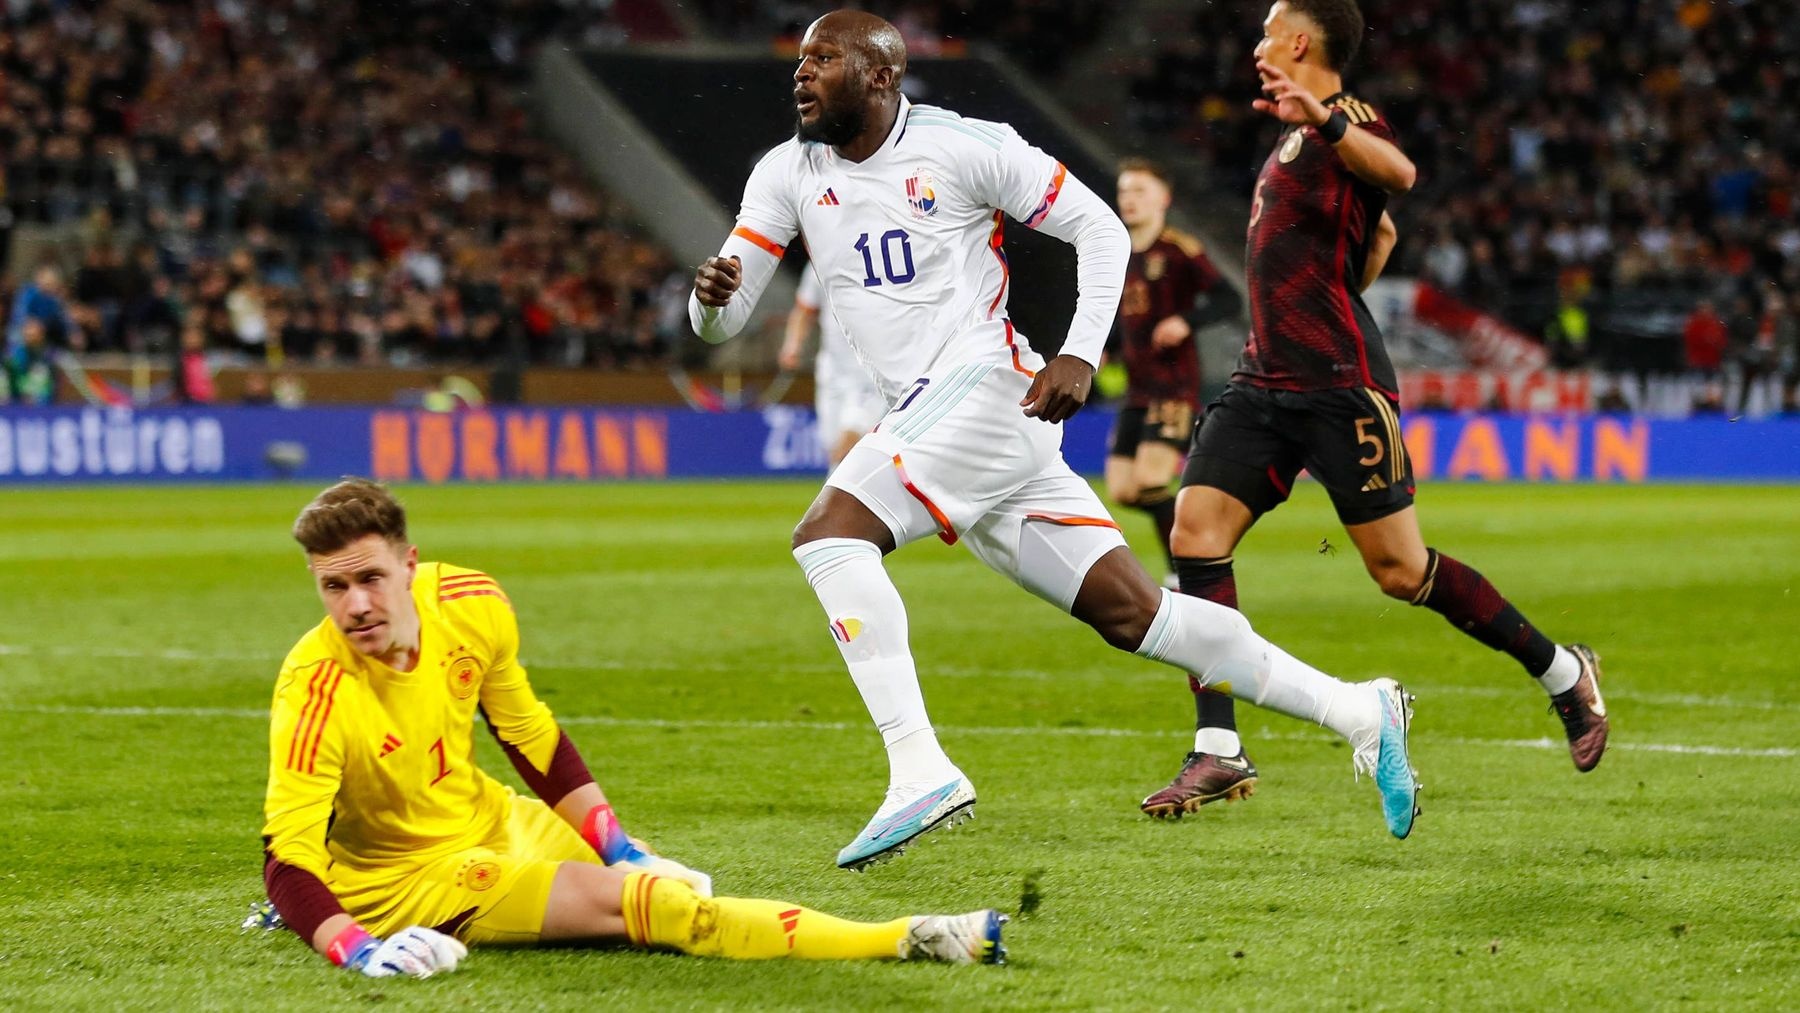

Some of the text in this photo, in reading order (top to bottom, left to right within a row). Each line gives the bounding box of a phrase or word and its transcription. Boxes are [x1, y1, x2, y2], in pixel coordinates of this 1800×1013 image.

[854, 229, 916, 287] 10
[1354, 417, 1384, 467] 5
[428, 737, 453, 788] 1
